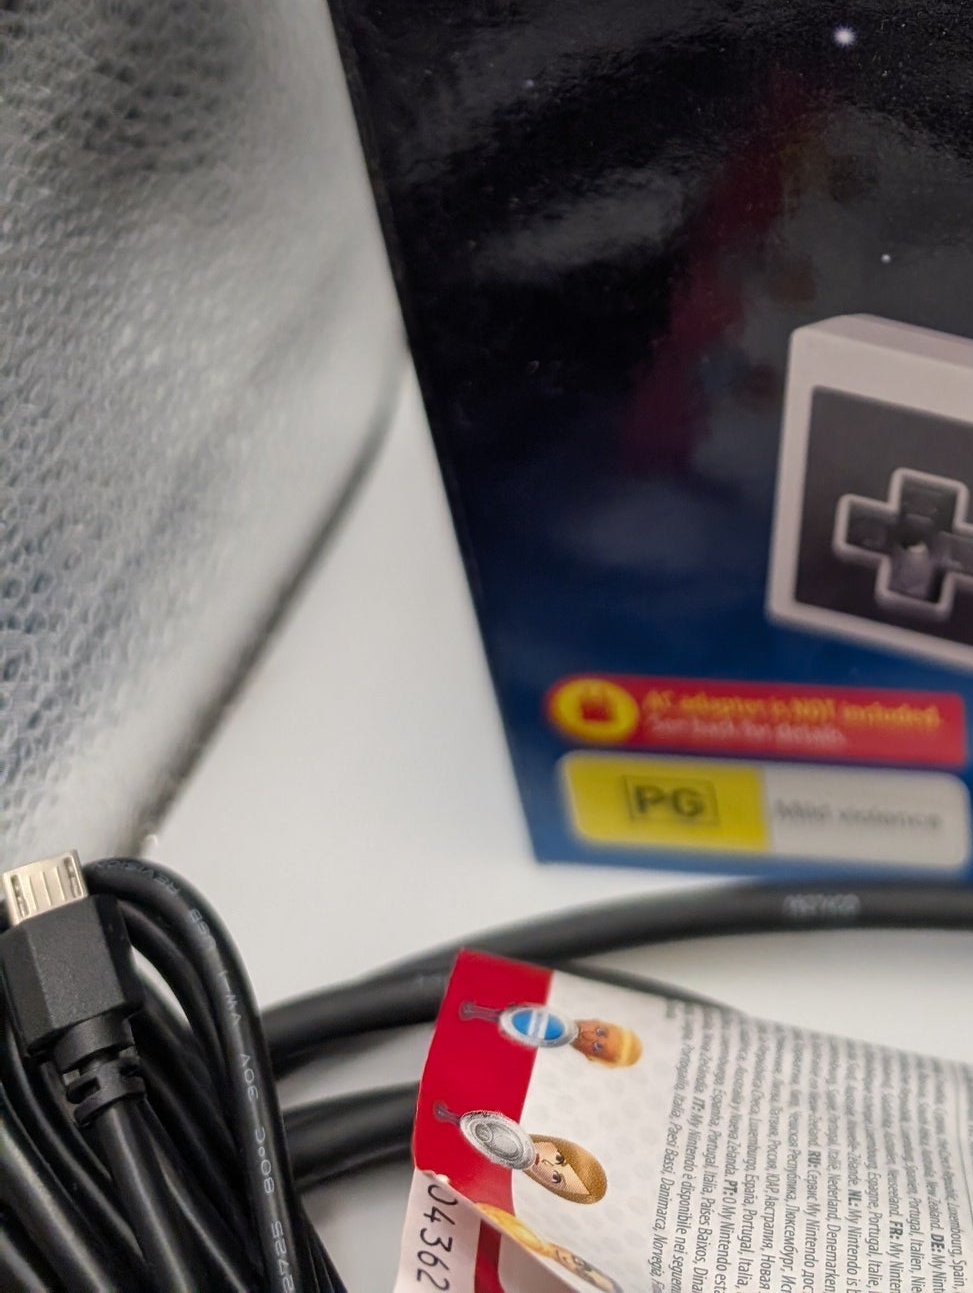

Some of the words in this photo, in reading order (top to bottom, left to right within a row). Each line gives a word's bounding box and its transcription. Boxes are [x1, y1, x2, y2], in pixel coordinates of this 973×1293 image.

[634, 784, 705, 819] PG
[668, 1093, 686, 1120] Italia,
[687, 1112, 704, 1128] My
[692, 1096, 705, 1112] IT:
[666, 1122, 683, 1148] Paesi
[683, 1128, 702, 1171] Nintendo
[702, 1129, 722, 1168] Portugal,
[743, 1117, 762, 1172] Luxemburgo,
[660, 1148, 680, 1175] Bassi,
[725, 1139, 742, 1177] Zelanda.
[765, 1139, 782, 1171] Россия,
[808, 1150, 821, 1168] RU:
[700, 1171, 719, 1195] Itália,
[723, 1179, 738, 1196] PT:
[741, 1174, 759, 1207] España,
[764, 1173, 780, 1193] ЮАР,
[784, 1148, 801, 1202] Республика,
[804, 1169, 821, 1201] Сервис
[652, 1177, 675, 1231] Danimarca,
[676, 1181, 695, 1235] disponibile
[699, 1197, 716, 1225] Países
[718, 1205, 737, 1220] My
[803, 1202, 821, 1217] My
[825, 1173, 842, 1221] Nederland,
[847, 1189, 862, 1206] NL:
[928, 1196, 944, 1230] Zealand.
[737, 1208, 757, 1255] Portugal,
[760, 1195, 779, 1251] Австралия,
[844, 1208, 862, 1224] My
[889, 1220, 904, 1239] FR:
[906, 1197, 925, 1235] Portugal,
[947, 1202, 965, 1257] Luxembourg,
[673, 1236, 688, 1254] nei
[692, 1227, 713, 1264] Baixos,
[716, 1221, 736, 1271] Nintendo
[779, 1204, 800, 1272] Люксембург,
[804, 1219, 821, 1268] Nintendo
[847, 1225, 862, 1275] Nintendo
[864, 1211, 883, 1257] Portugal,
[930, 1233, 945, 1253] DE:
[648, 1233, 668, 1277] Norvegia,
[885, 1242, 904, 1259] My
[907, 1238, 925, 1273] Italien,
[927, 1253, 946, 1270] My
[735, 1257, 755, 1289] Italia,
[759, 1254, 776, 1290] Новая
[846, 1277, 861, 1286] is
[866, 1259, 883, 1289] Italie,
[949, 1259, 967, 1289] Spain,
